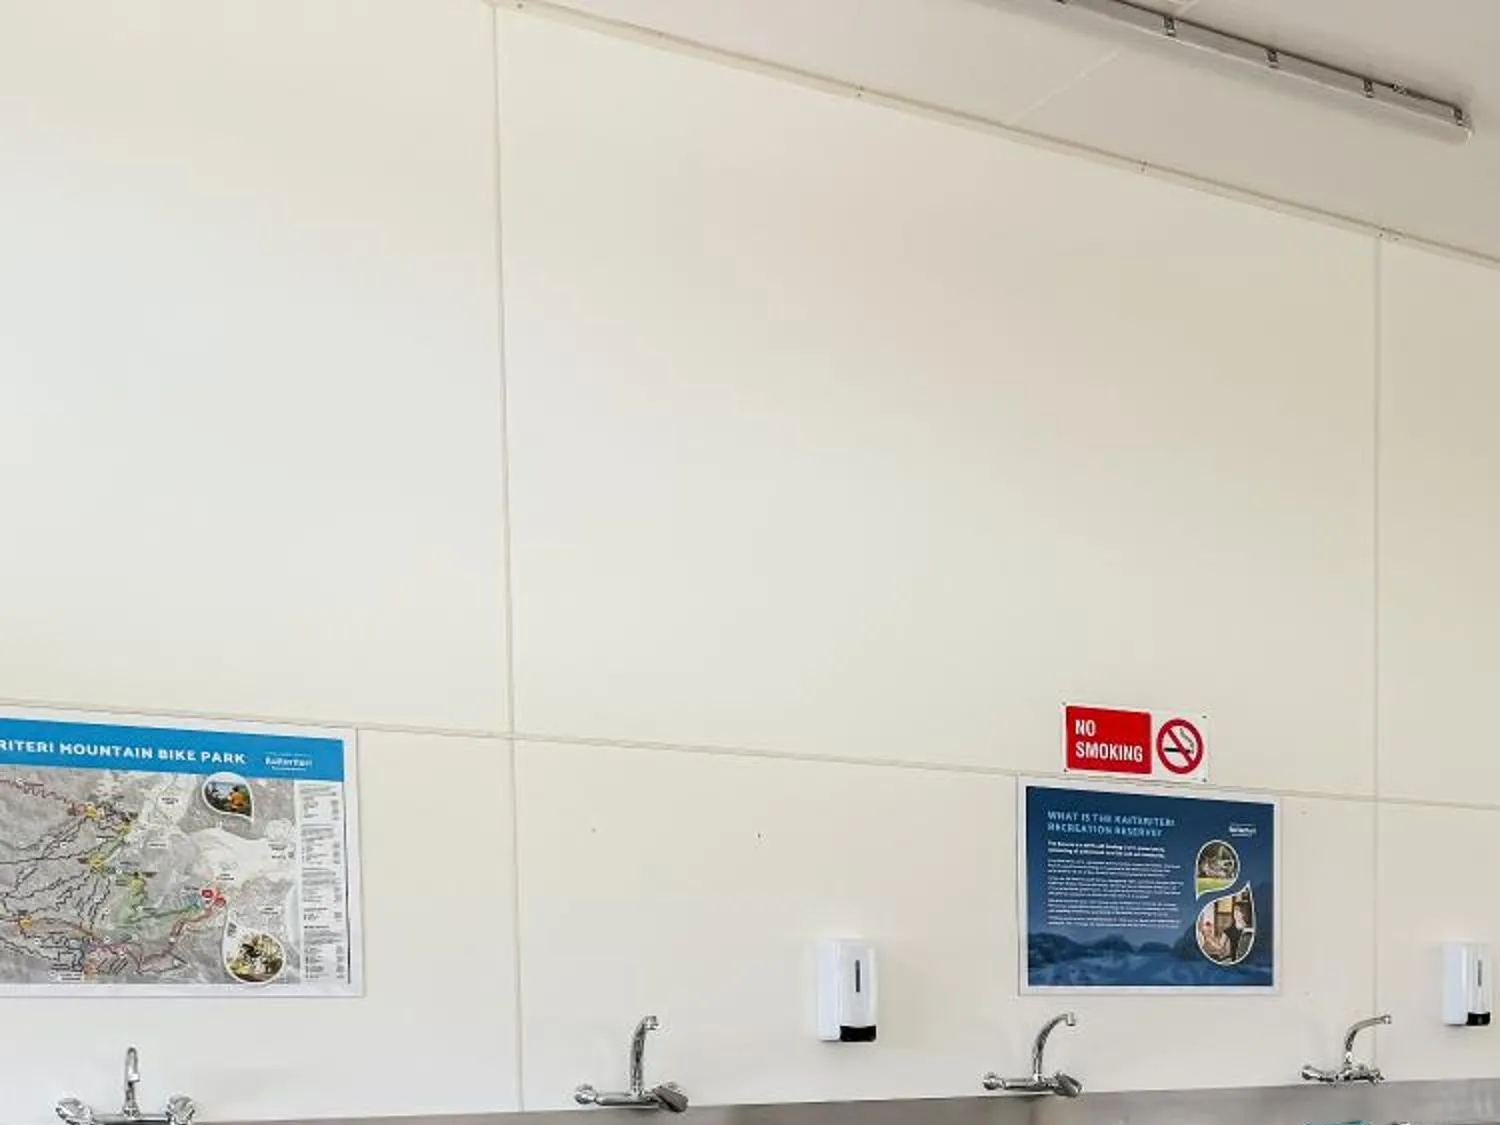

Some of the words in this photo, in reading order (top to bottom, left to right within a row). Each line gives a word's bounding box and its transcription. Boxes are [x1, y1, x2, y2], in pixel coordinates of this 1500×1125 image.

[1075, 719, 1096, 737] NO
[60, 743, 153, 759] MOUNTAIN
[158, 750, 196, 761] BIKE
[201, 751, 246, 764] PARK
[1075, 741, 1143, 763] SMOKING
[1048, 810, 1078, 821] WHAT
[1081, 813, 1090, 822] IS
[1048, 822, 1112, 834] RECREATION
